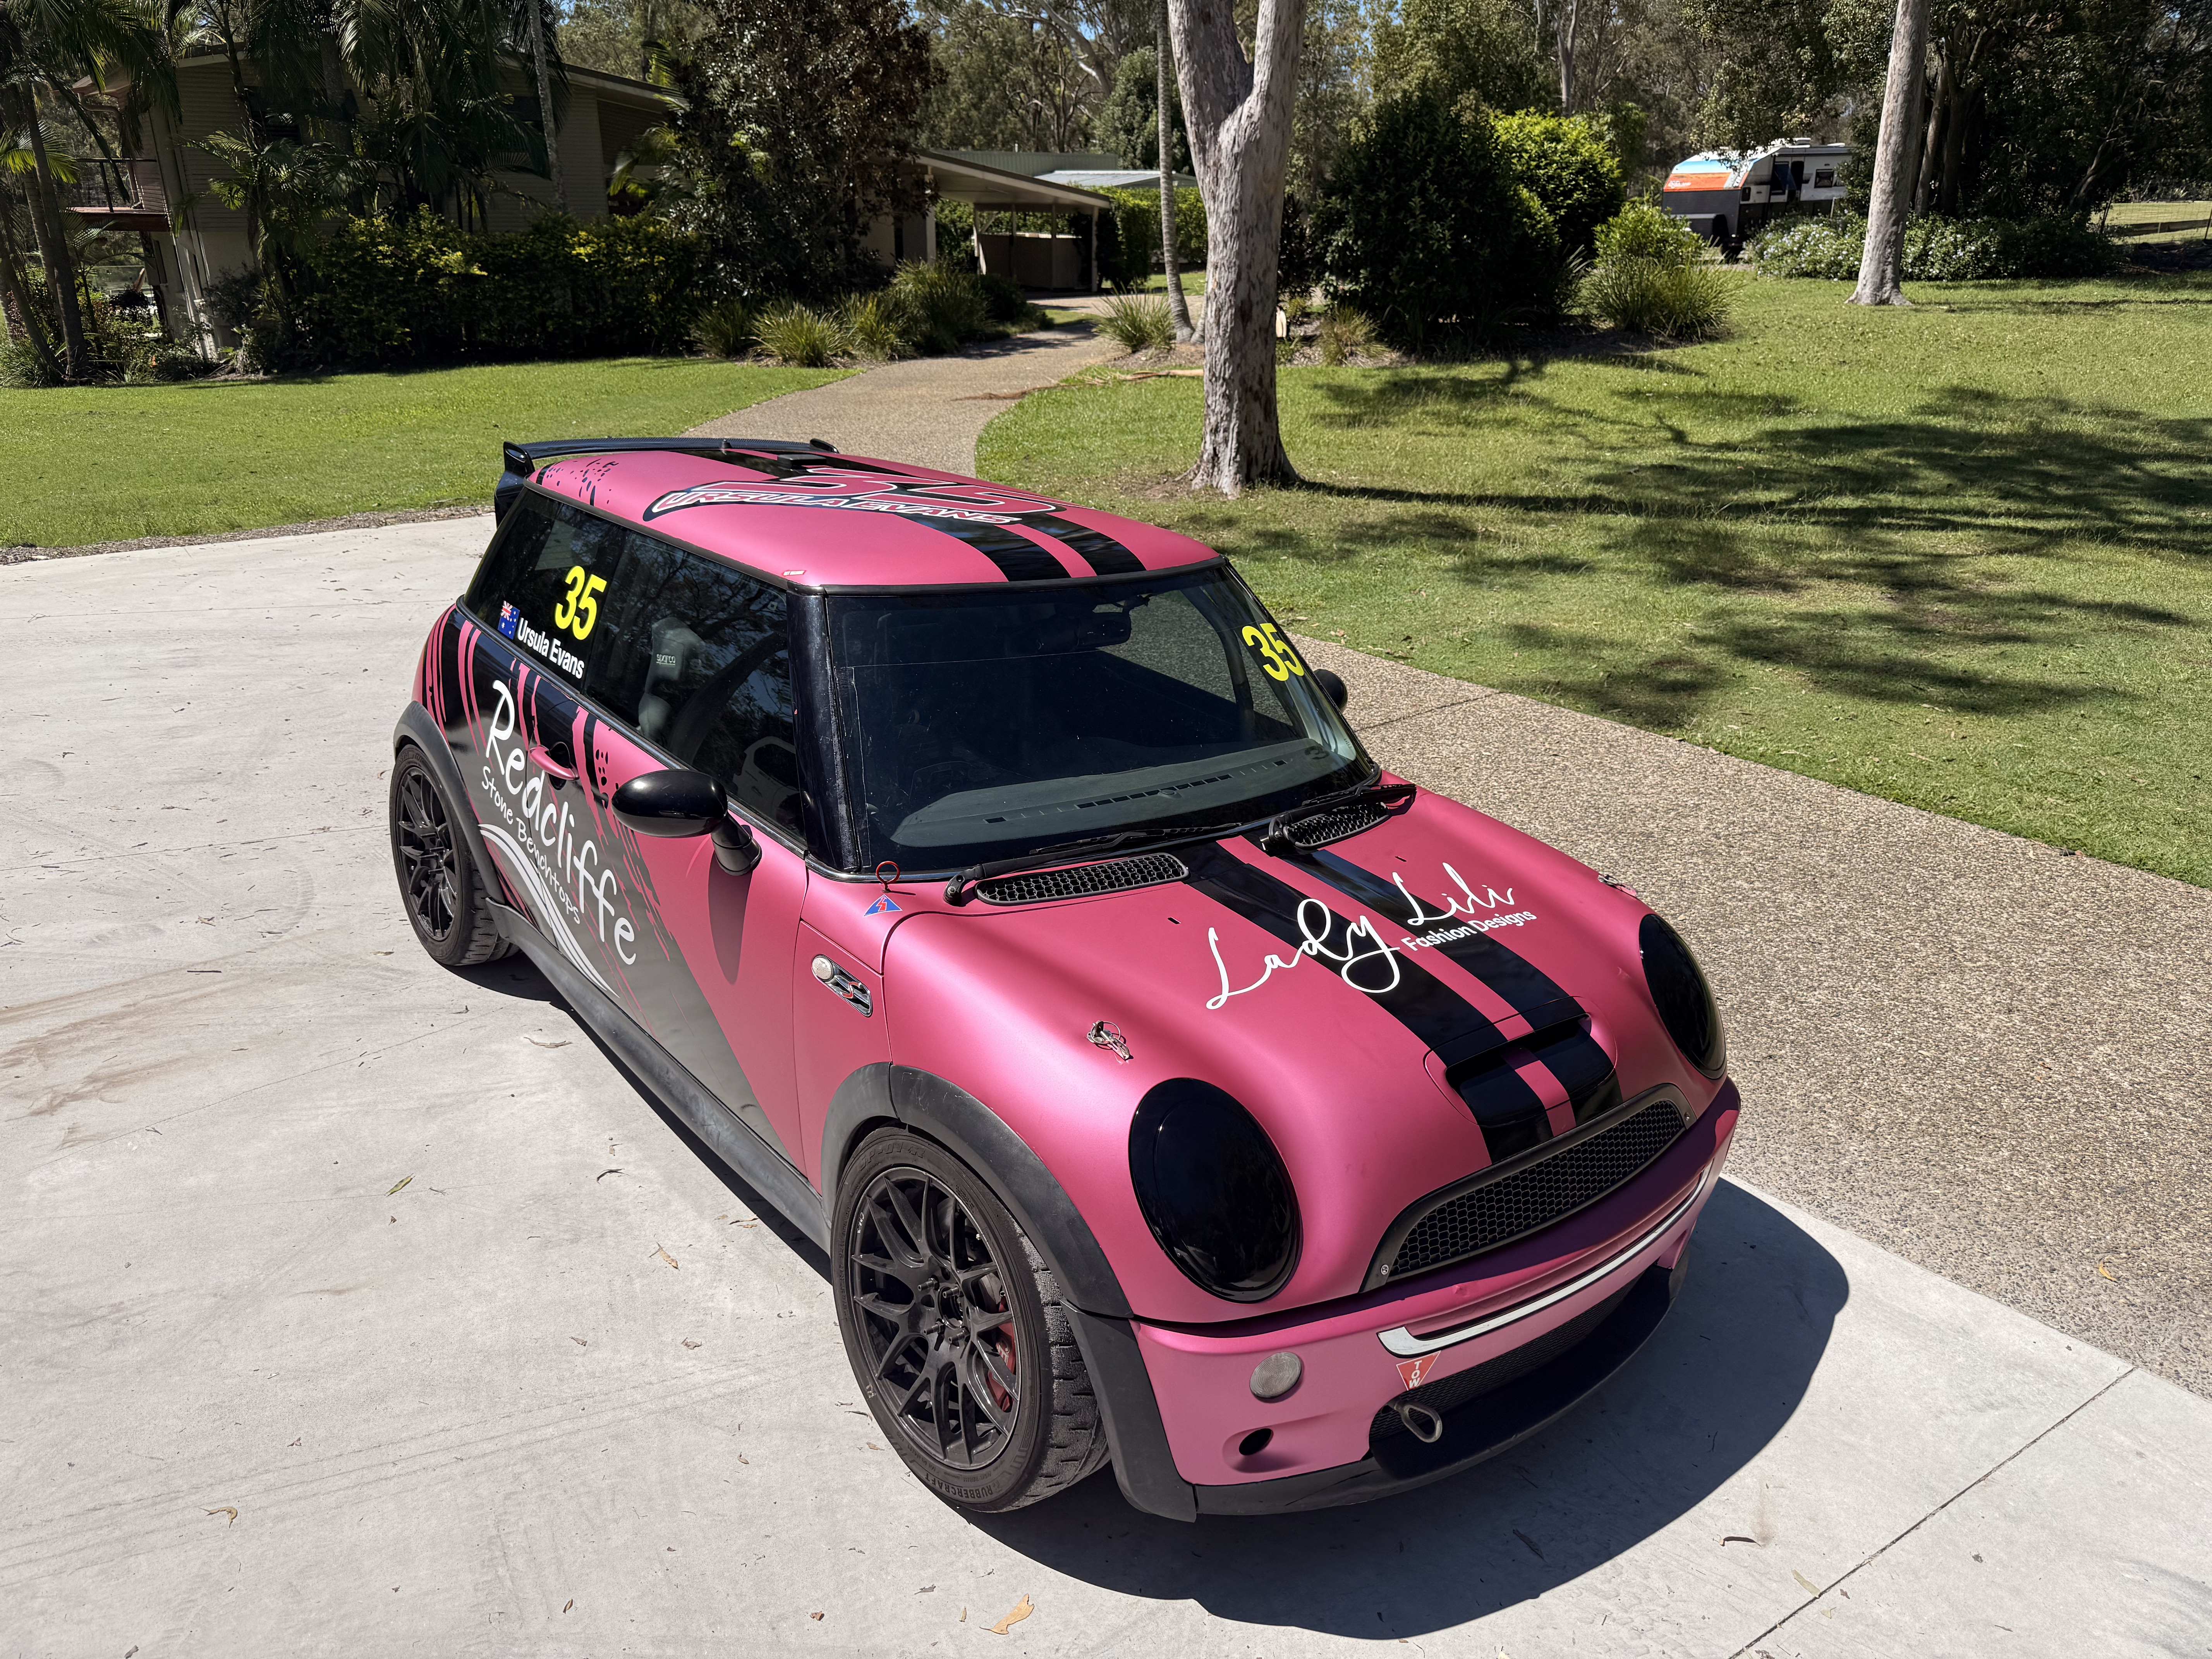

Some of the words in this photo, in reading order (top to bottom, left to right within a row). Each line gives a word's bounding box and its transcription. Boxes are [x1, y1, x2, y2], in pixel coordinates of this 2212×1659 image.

[652, 491, 850, 512] URSULA
[841, 499, 1022, 524] EVANS
[555, 566, 607, 641] 35
[518, 617, 550, 657] Ursula
[549, 638, 585, 679] Evans
[1242, 623, 1304, 681] 35
[481, 766, 514, 825] Stone
[516, 817, 580, 924] Benchtops
[485, 680, 636, 965] Redcliffe
[1206, 898, 1400, 1010] Lady
[1401, 925, 1475, 951] Fashion
[1468, 910, 1537, 932] Designs
[1409, 1360, 1422, 1388] TOW
[924, 1473, 993, 1499] RUBBERCRAFT
